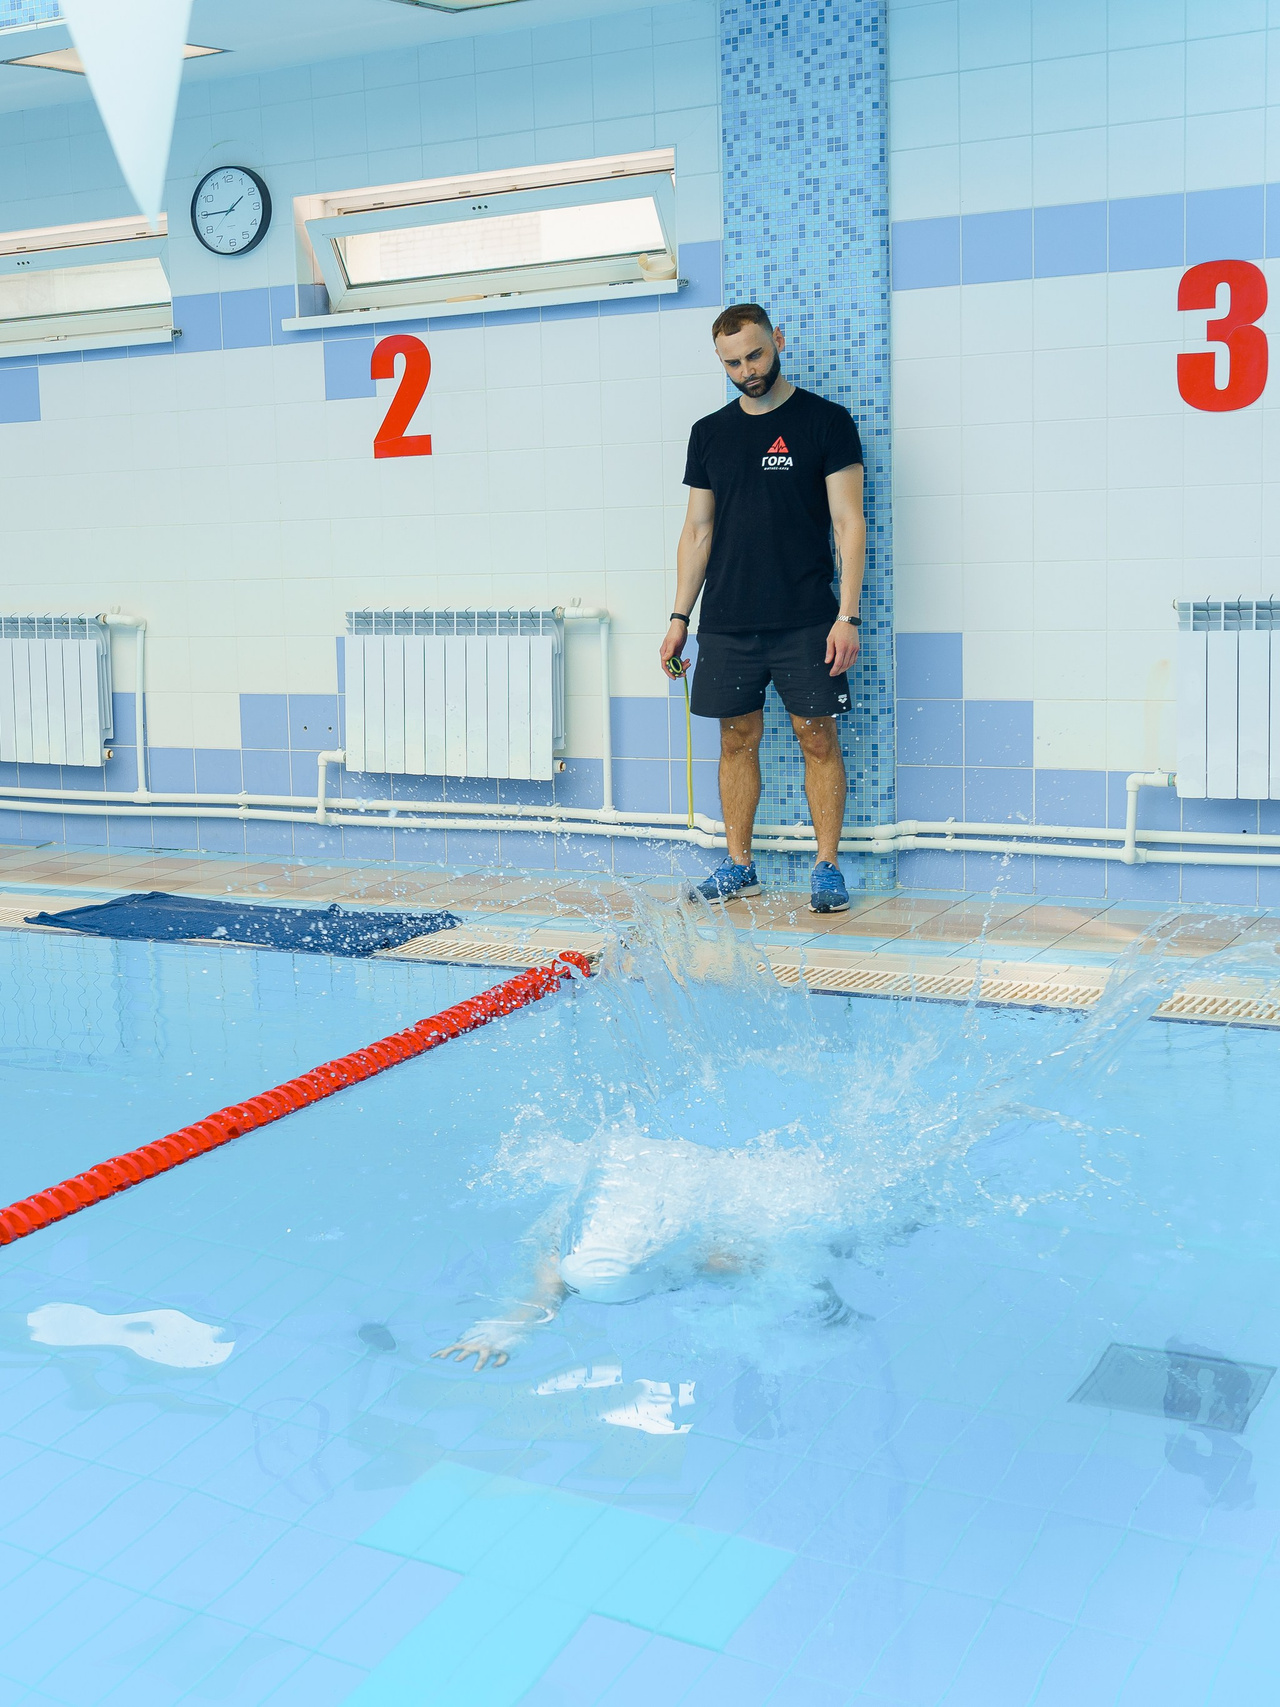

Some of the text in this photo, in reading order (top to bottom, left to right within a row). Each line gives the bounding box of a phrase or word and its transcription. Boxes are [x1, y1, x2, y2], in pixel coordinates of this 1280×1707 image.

[222, 174, 234, 184] 12
[239, 178, 244, 186] 1
[211, 182, 220, 190] 11
[247, 187, 256, 196] 2
[203, 194, 214, 203] 10
[252, 202, 261, 211] 3
[201, 210, 209, 220] 9
[250, 218, 258, 226] 4
[206, 225, 214, 234] 8
[216, 235, 224, 244] 7
[242, 231, 250, 240] 5
[229, 238, 237, 247] 6
[1176, 259, 1269, 413] 3
[370, 334, 432, 459] 2
[761, 456, 794, 467] ГОРА
